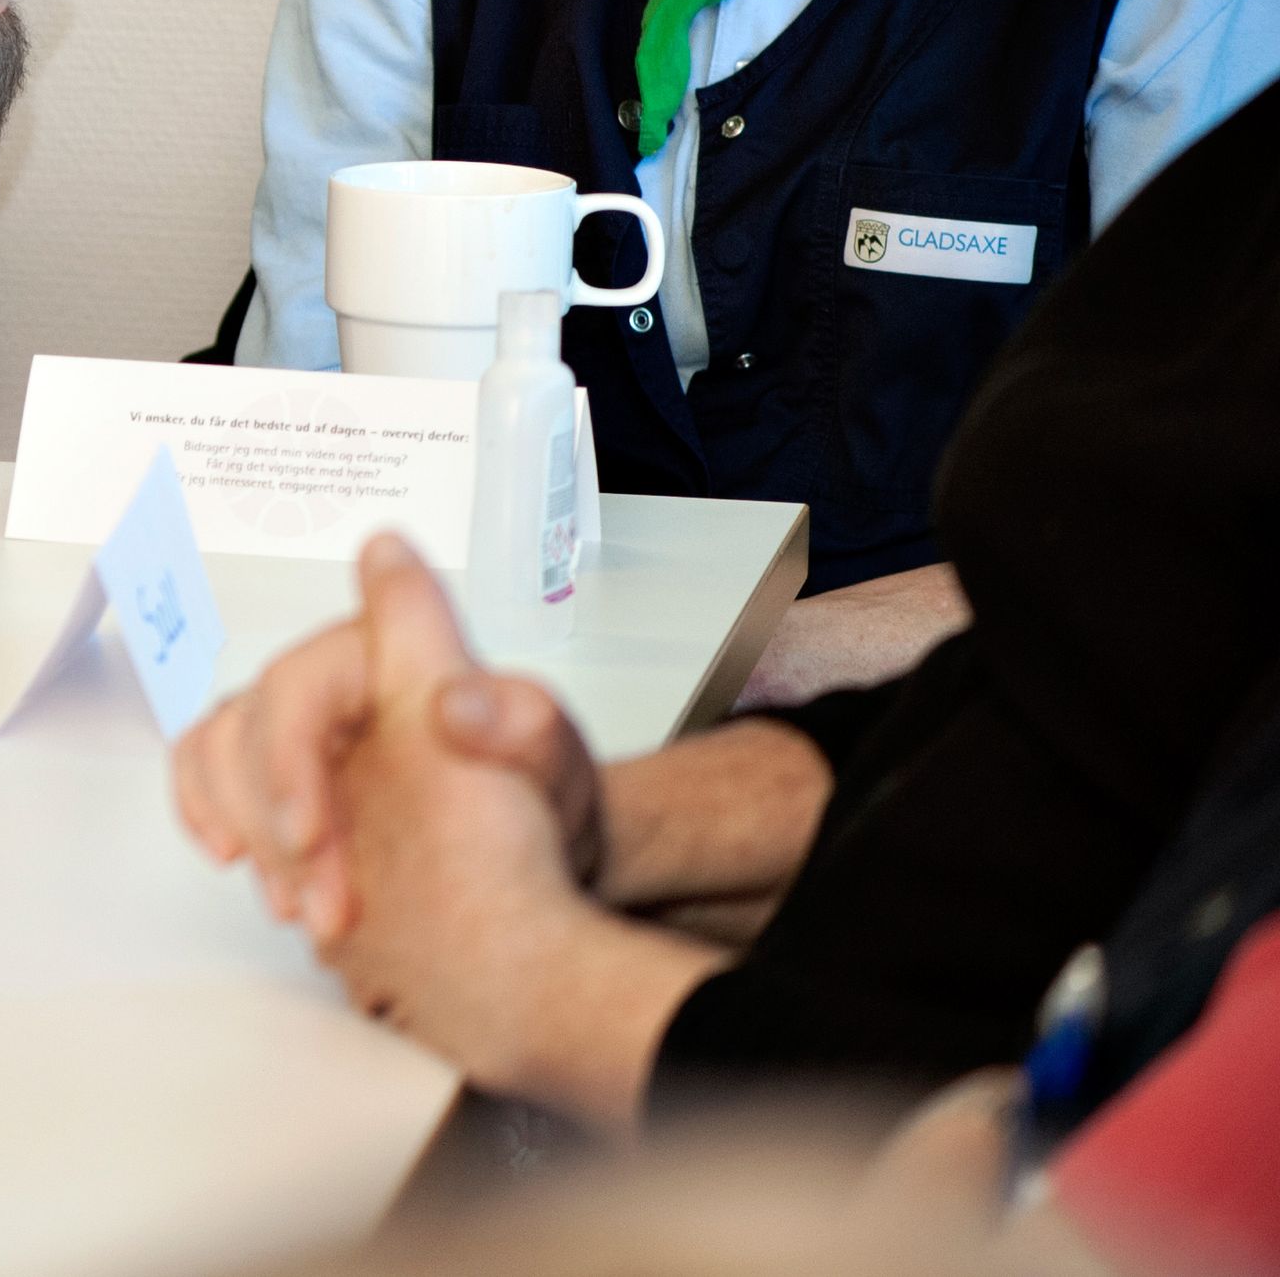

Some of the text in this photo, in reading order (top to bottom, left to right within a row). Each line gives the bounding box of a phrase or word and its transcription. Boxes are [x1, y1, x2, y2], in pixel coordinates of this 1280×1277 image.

[898, 228, 1008, 256] GLADSAXE
[130, 411, 142, 422] Vi
[145, 414, 186, 426] ønsker,
[190, 415, 205, 426] du
[209, 416, 226, 427] får
[230, 418, 249, 429] det
[253, 420, 291, 432] bedste
[295, 422, 310, 433] ud
[314, 423, 328, 434] af
[330, 424, 366, 437] dagen
[382, 429, 424, 442] overvej
[427, 431, 470, 443] derfor:
[184, 440, 409, 467] Bidrager jeg med min viden og erfaring?
[206, 458, 380, 480] Får jeg det vigtigste med hjem?
[188, 475, 206, 486] jeg
[209, 476, 276, 490] interesseret,
[279, 481, 335, 495] engageret
[338, 485, 352, 497] og
[355, 485, 409, 498] lyttende?
